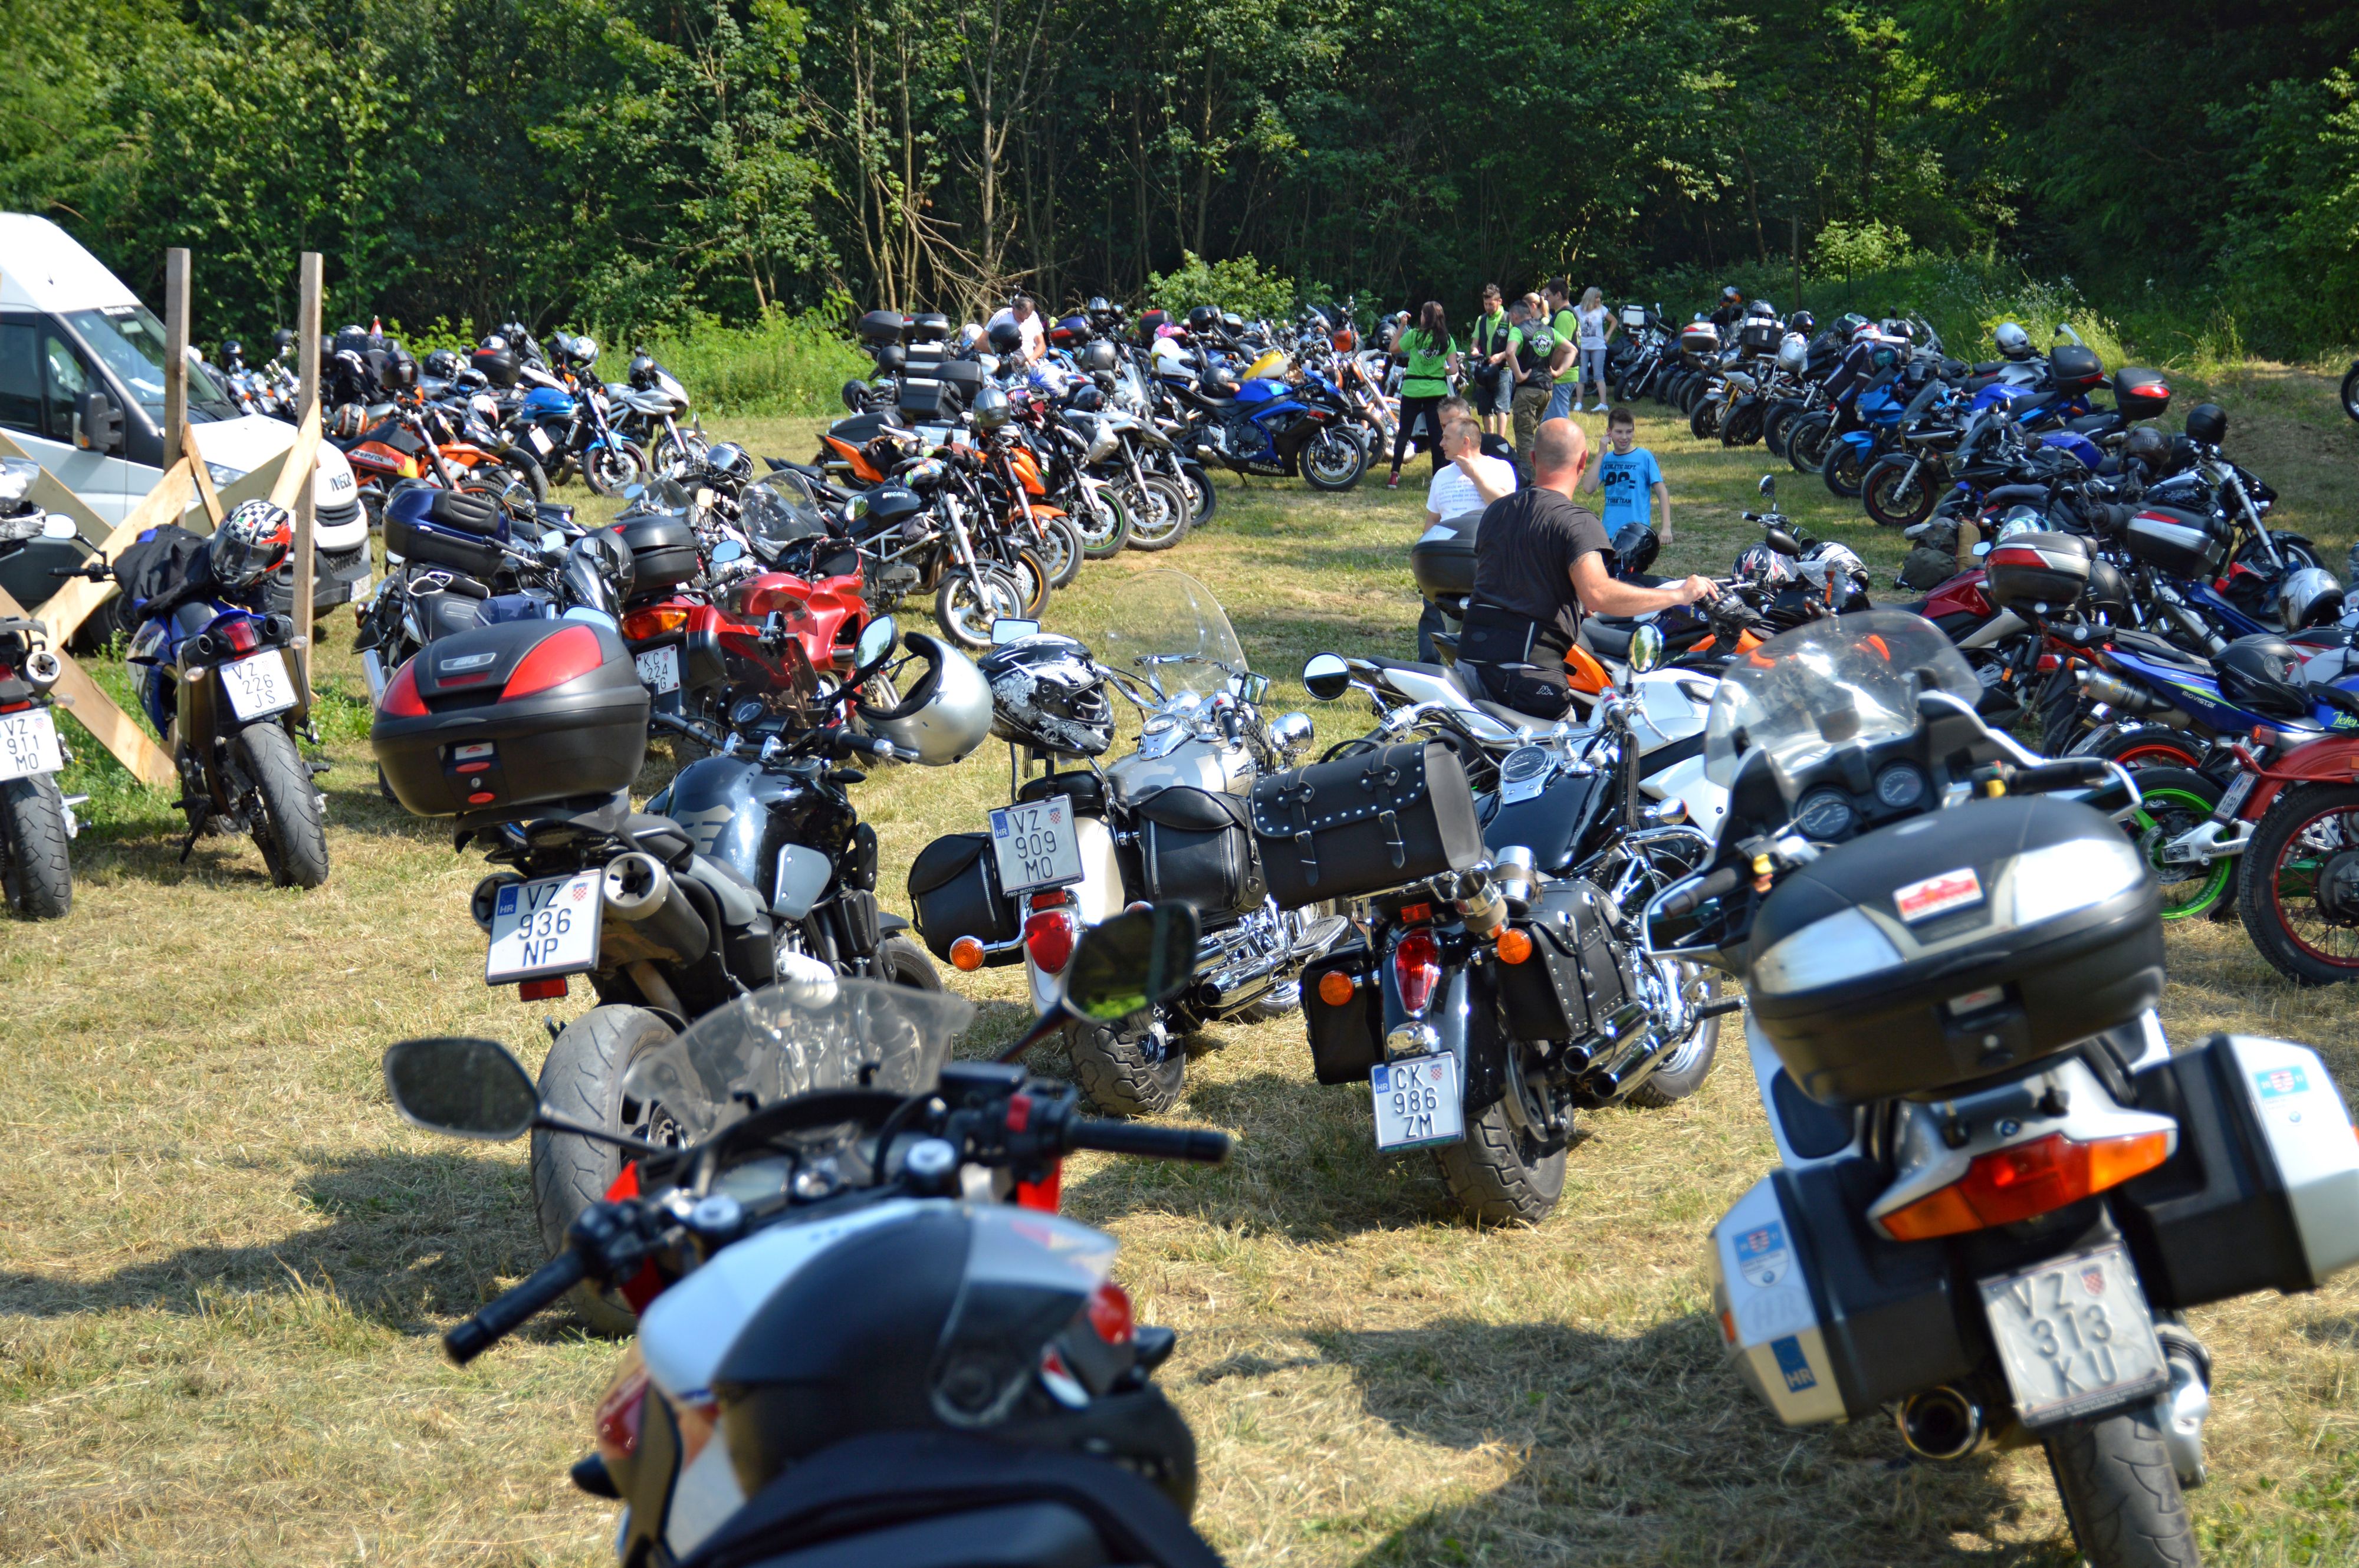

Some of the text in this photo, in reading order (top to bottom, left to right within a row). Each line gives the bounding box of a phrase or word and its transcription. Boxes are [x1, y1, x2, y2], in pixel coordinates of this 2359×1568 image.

[353, 449, 384, 462] REPSOL
[1249, 462, 1285, 474] SUZUKI
[643, 652, 660, 668] KC
[232, 662, 258, 680] VZ
[646, 662, 668, 680] 224
[242, 673, 274, 695] 226
[255, 689, 276, 708] JS
[4, 718, 29, 737] VZ
[6, 734, 40, 755] 911
[15, 752, 39, 772] MO
[1012, 808, 1043, 834] VZ
[995, 828, 1008, 837] HR
[1015, 830, 1057, 859] 909
[2200, 844, 2239, 856] PGM-FI
[1024, 856, 1054, 883] MO
[527, 882, 561, 911] VZ
[1007, 886, 1036, 898] PRO-MOTO
[499, 903, 515, 915] HR
[517, 908, 572, 940] 936
[523, 937, 559, 968] NP
[1376, 1082, 1389, 1092] HR
[1395, 1063, 1425, 1090] CK
[1394, 1086, 1439, 1115] 986
[1403, 1111, 1435, 1139] ZM
[2006, 1269, 2075, 1320] VZ
[2031, 1303, 2114, 1359] 313
[1783, 1366, 1815, 1388] HR
[2051, 1344, 2120, 1398] KU
